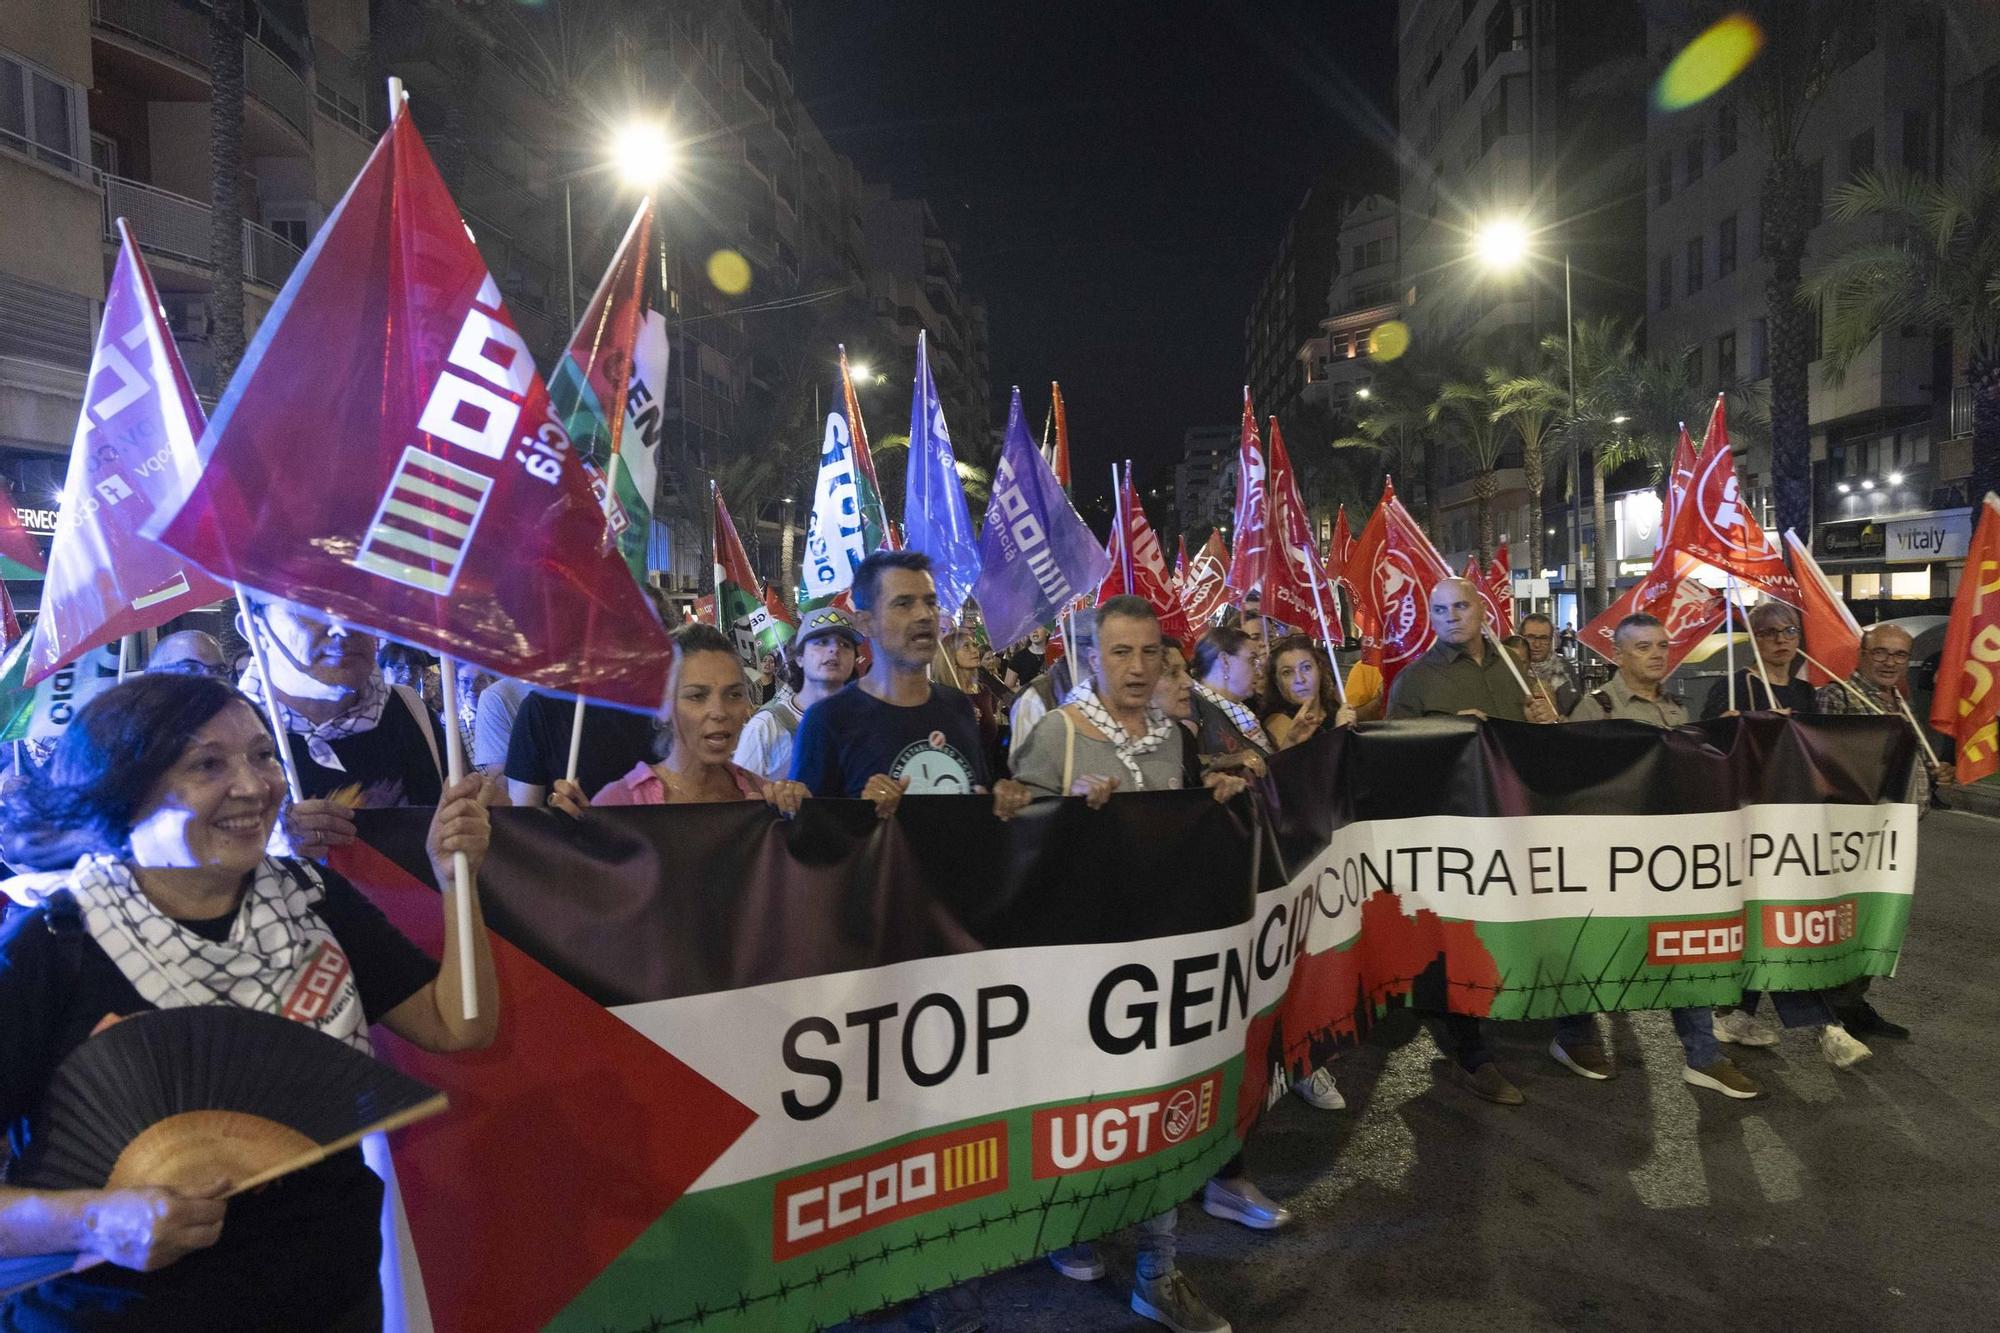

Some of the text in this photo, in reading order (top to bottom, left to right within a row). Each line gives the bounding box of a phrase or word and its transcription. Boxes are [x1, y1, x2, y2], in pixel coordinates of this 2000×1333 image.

[1897, 526, 1946, 554] vitaly
[1656, 925, 1744, 957] CCOO
[1775, 909, 1837, 945] UGT
[779, 983, 1030, 1122] STOP
[1318, 846, 1516, 920] CONTRA
[1530, 846, 1587, 894] EL
[1609, 839, 1744, 892] POBL
[1750, 819, 1897, 876] PALESTÍ!
[1050, 1101, 1160, 1170] UGT
[786, 1151, 937, 1243] CCOO
